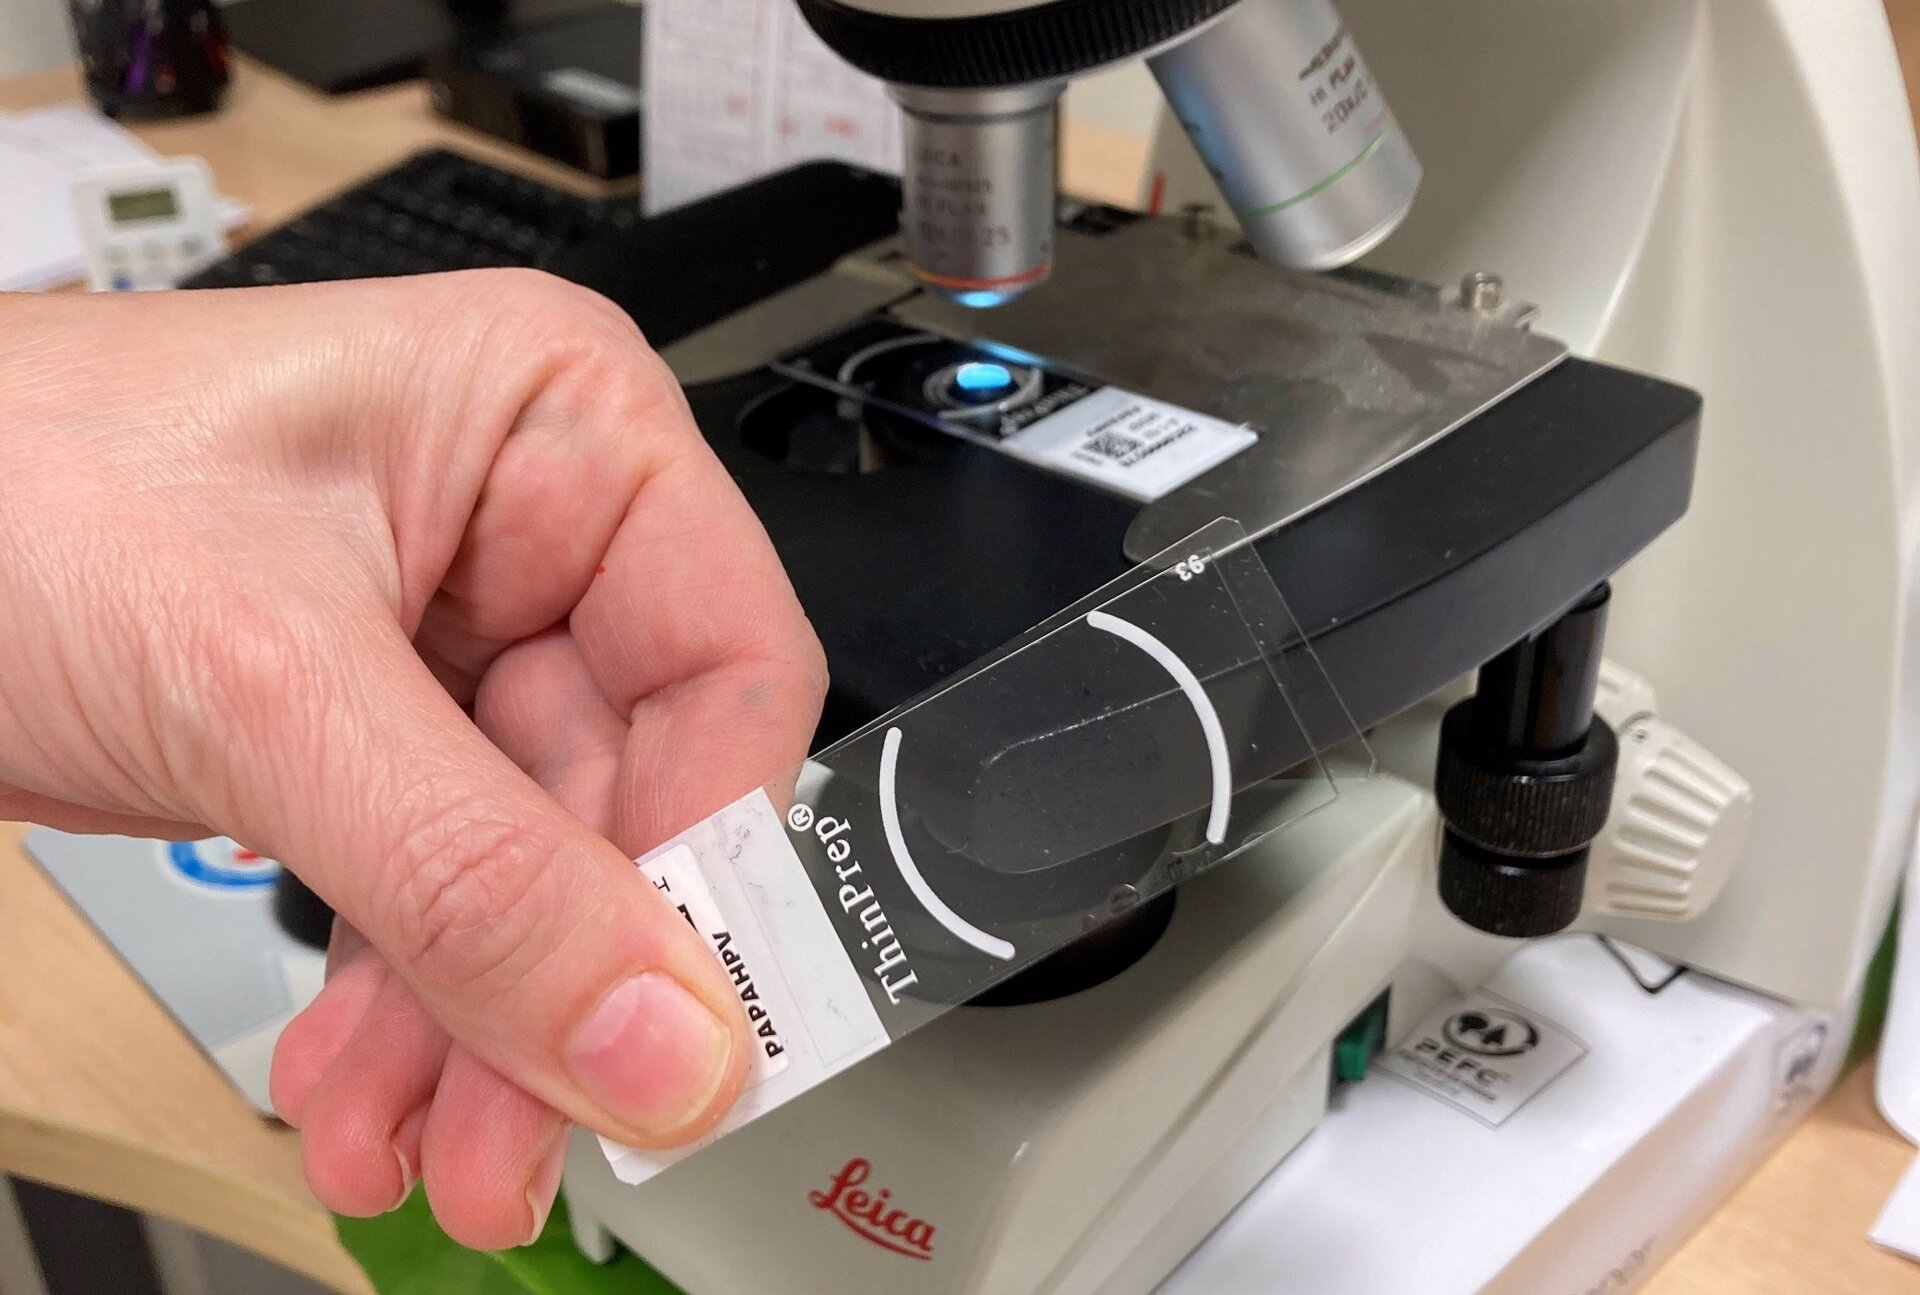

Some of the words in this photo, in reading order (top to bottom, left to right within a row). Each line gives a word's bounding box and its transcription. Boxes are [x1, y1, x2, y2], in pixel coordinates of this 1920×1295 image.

[712, 931, 784, 1058] PAPAHPV
[1414, 1037, 1502, 1084] PEFC
[807, 1157, 936, 1261] Leica
